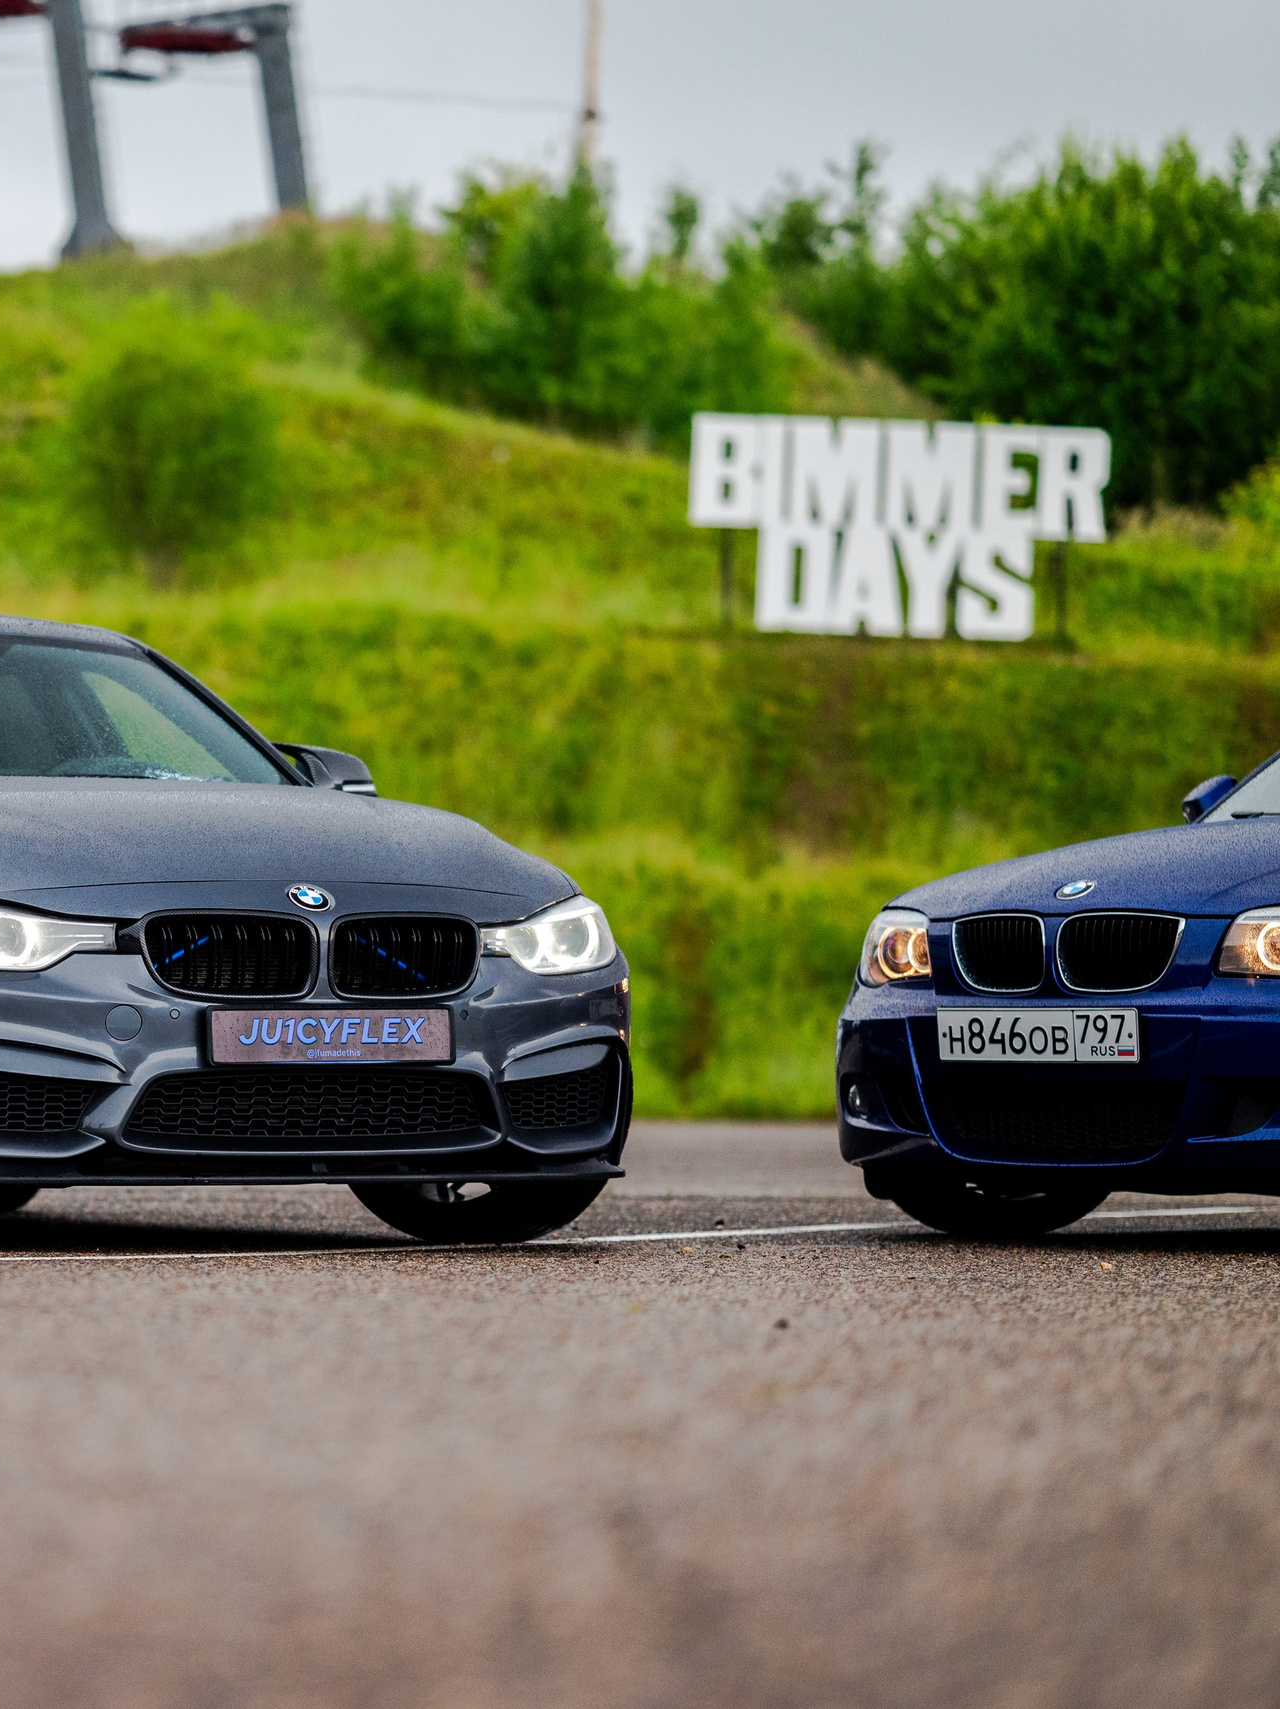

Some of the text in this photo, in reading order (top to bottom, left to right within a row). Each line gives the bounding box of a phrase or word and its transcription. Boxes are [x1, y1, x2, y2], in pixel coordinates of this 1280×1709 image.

[688, 411, 1112, 543] BIMMER
[754, 521, 1036, 642] DAYS
[238, 1016, 426, 1045] JU1CYFLEX
[1075, 1014, 1126, 1044] 797
[306, 1049, 361, 1059] @jfumadethis
[1090, 1045, 1116, 1057] RUS
